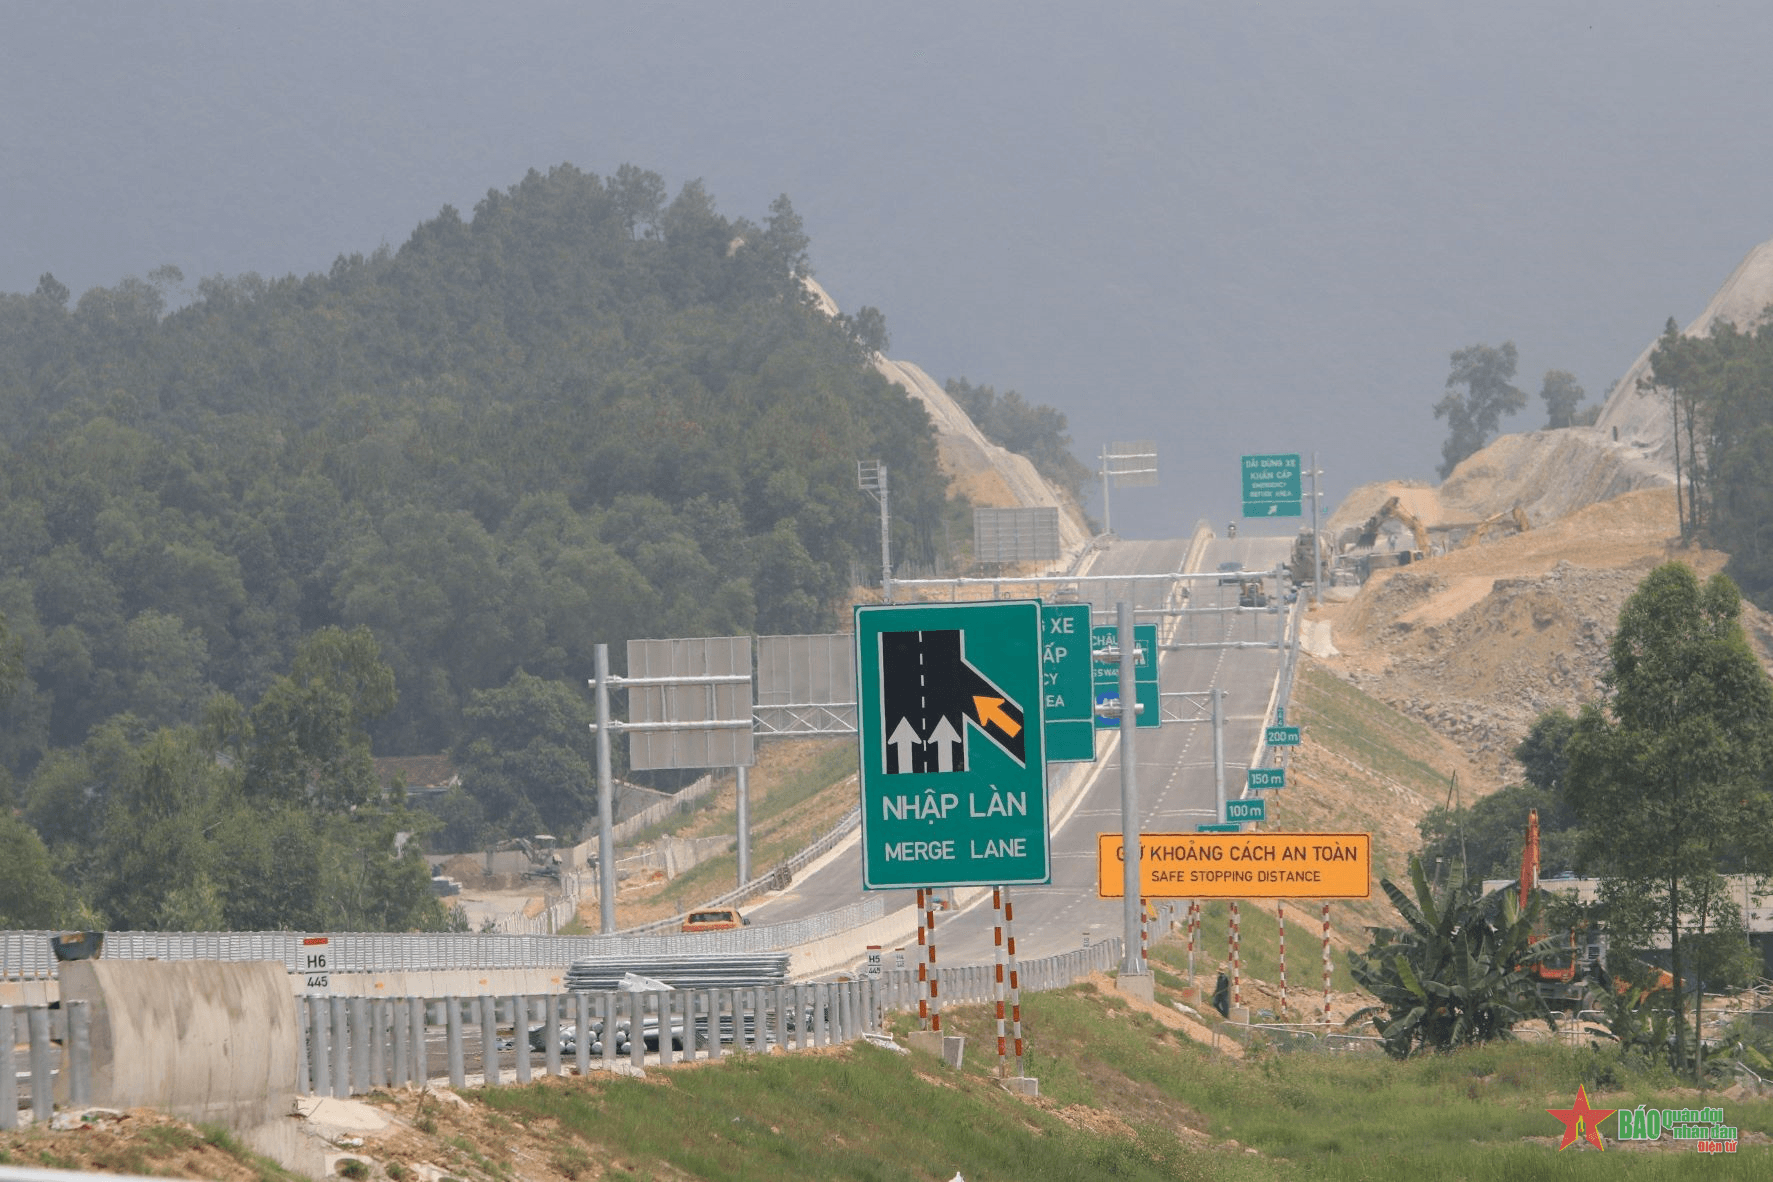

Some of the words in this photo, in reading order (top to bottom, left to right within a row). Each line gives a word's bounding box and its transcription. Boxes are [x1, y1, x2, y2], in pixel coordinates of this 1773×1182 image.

[1050, 617, 1074, 634] XE
[1268, 731, 1286, 742] 200
[1288, 733, 1298, 741] m
[1251, 773, 1268, 785] 150
[1270, 775, 1281, 784] m
[882, 788, 959, 825] NHẬP
[969, 784, 1027, 818] LÀN
[1229, 804, 1248, 817] 100
[1250, 807, 1261, 816] m
[885, 840, 956, 862] MERGE
[970, 838, 1027, 859] LANE
[1150, 840, 1223, 861] KHOẢNG
[1230, 840, 1275, 861] CÁCH
[1282, 846, 1306, 861] AN
[1312, 841, 1357, 861] TOÀN
[1151, 870, 1185, 882] SAFE
[1190, 870, 1253, 882] STOPPING
[1258, 870, 1321, 882] DISTANCE
[307, 954, 326, 968] H6
[307, 975, 328, 987] 445
